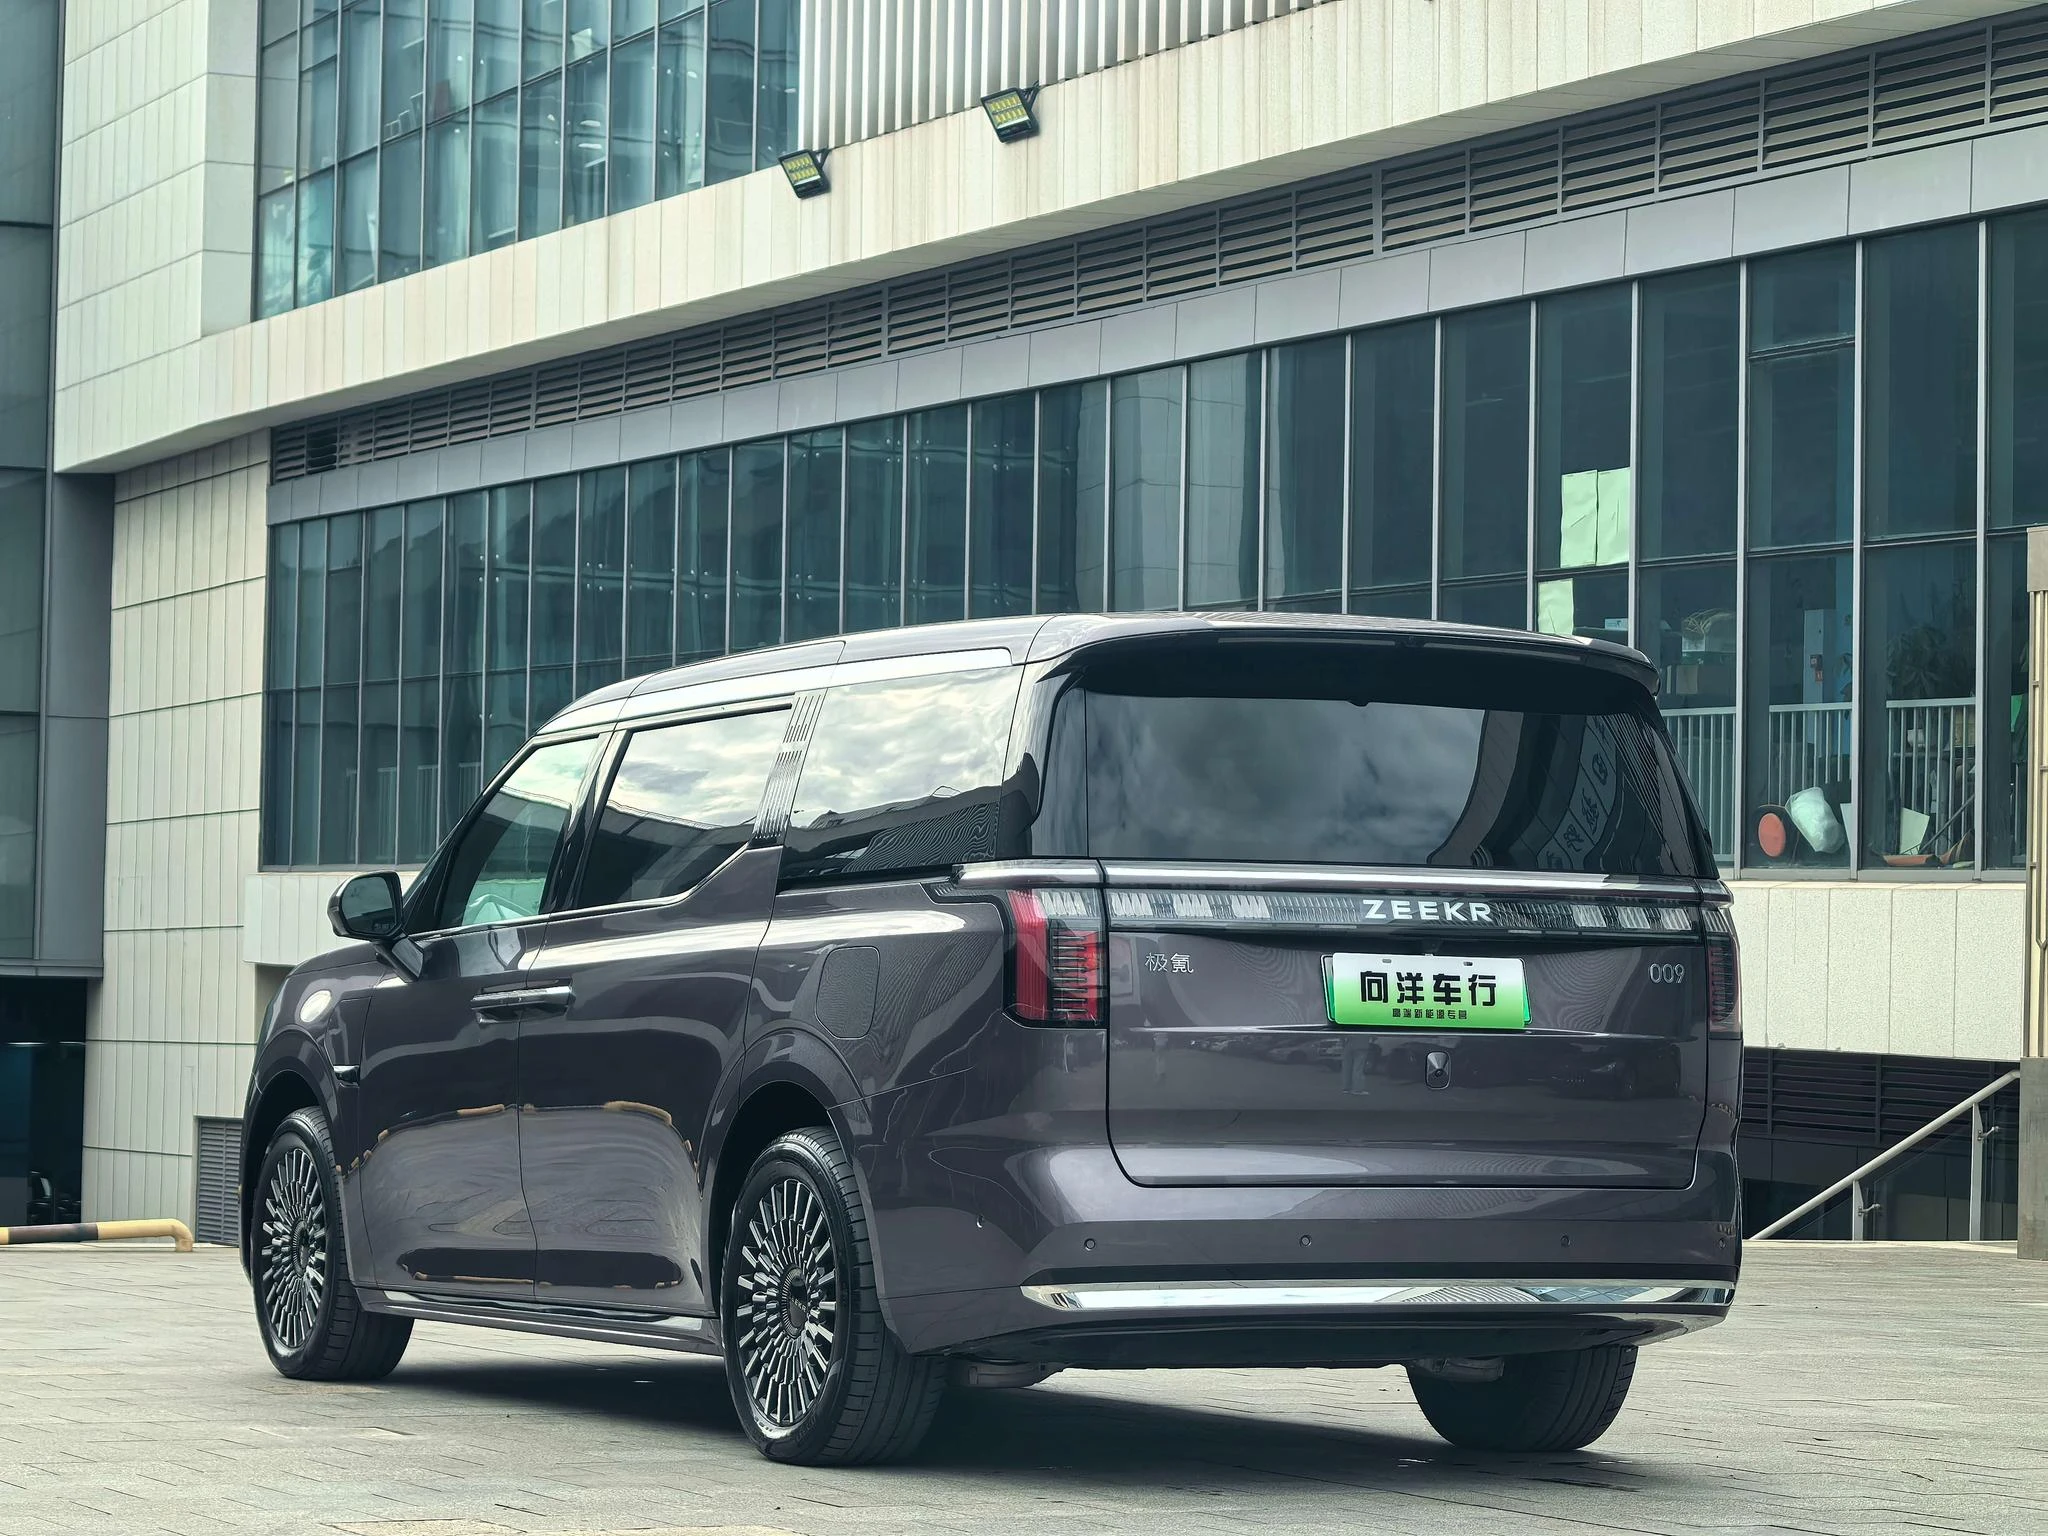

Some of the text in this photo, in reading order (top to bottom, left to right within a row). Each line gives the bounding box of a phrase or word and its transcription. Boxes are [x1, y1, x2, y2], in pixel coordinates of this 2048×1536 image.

[1362, 899, 1494, 921] ZEEKR
[1144, 952, 1195, 973] 极氪
[1649, 963, 1685, 984] 009
[1360, 970, 1497, 1007] 向洋车行
